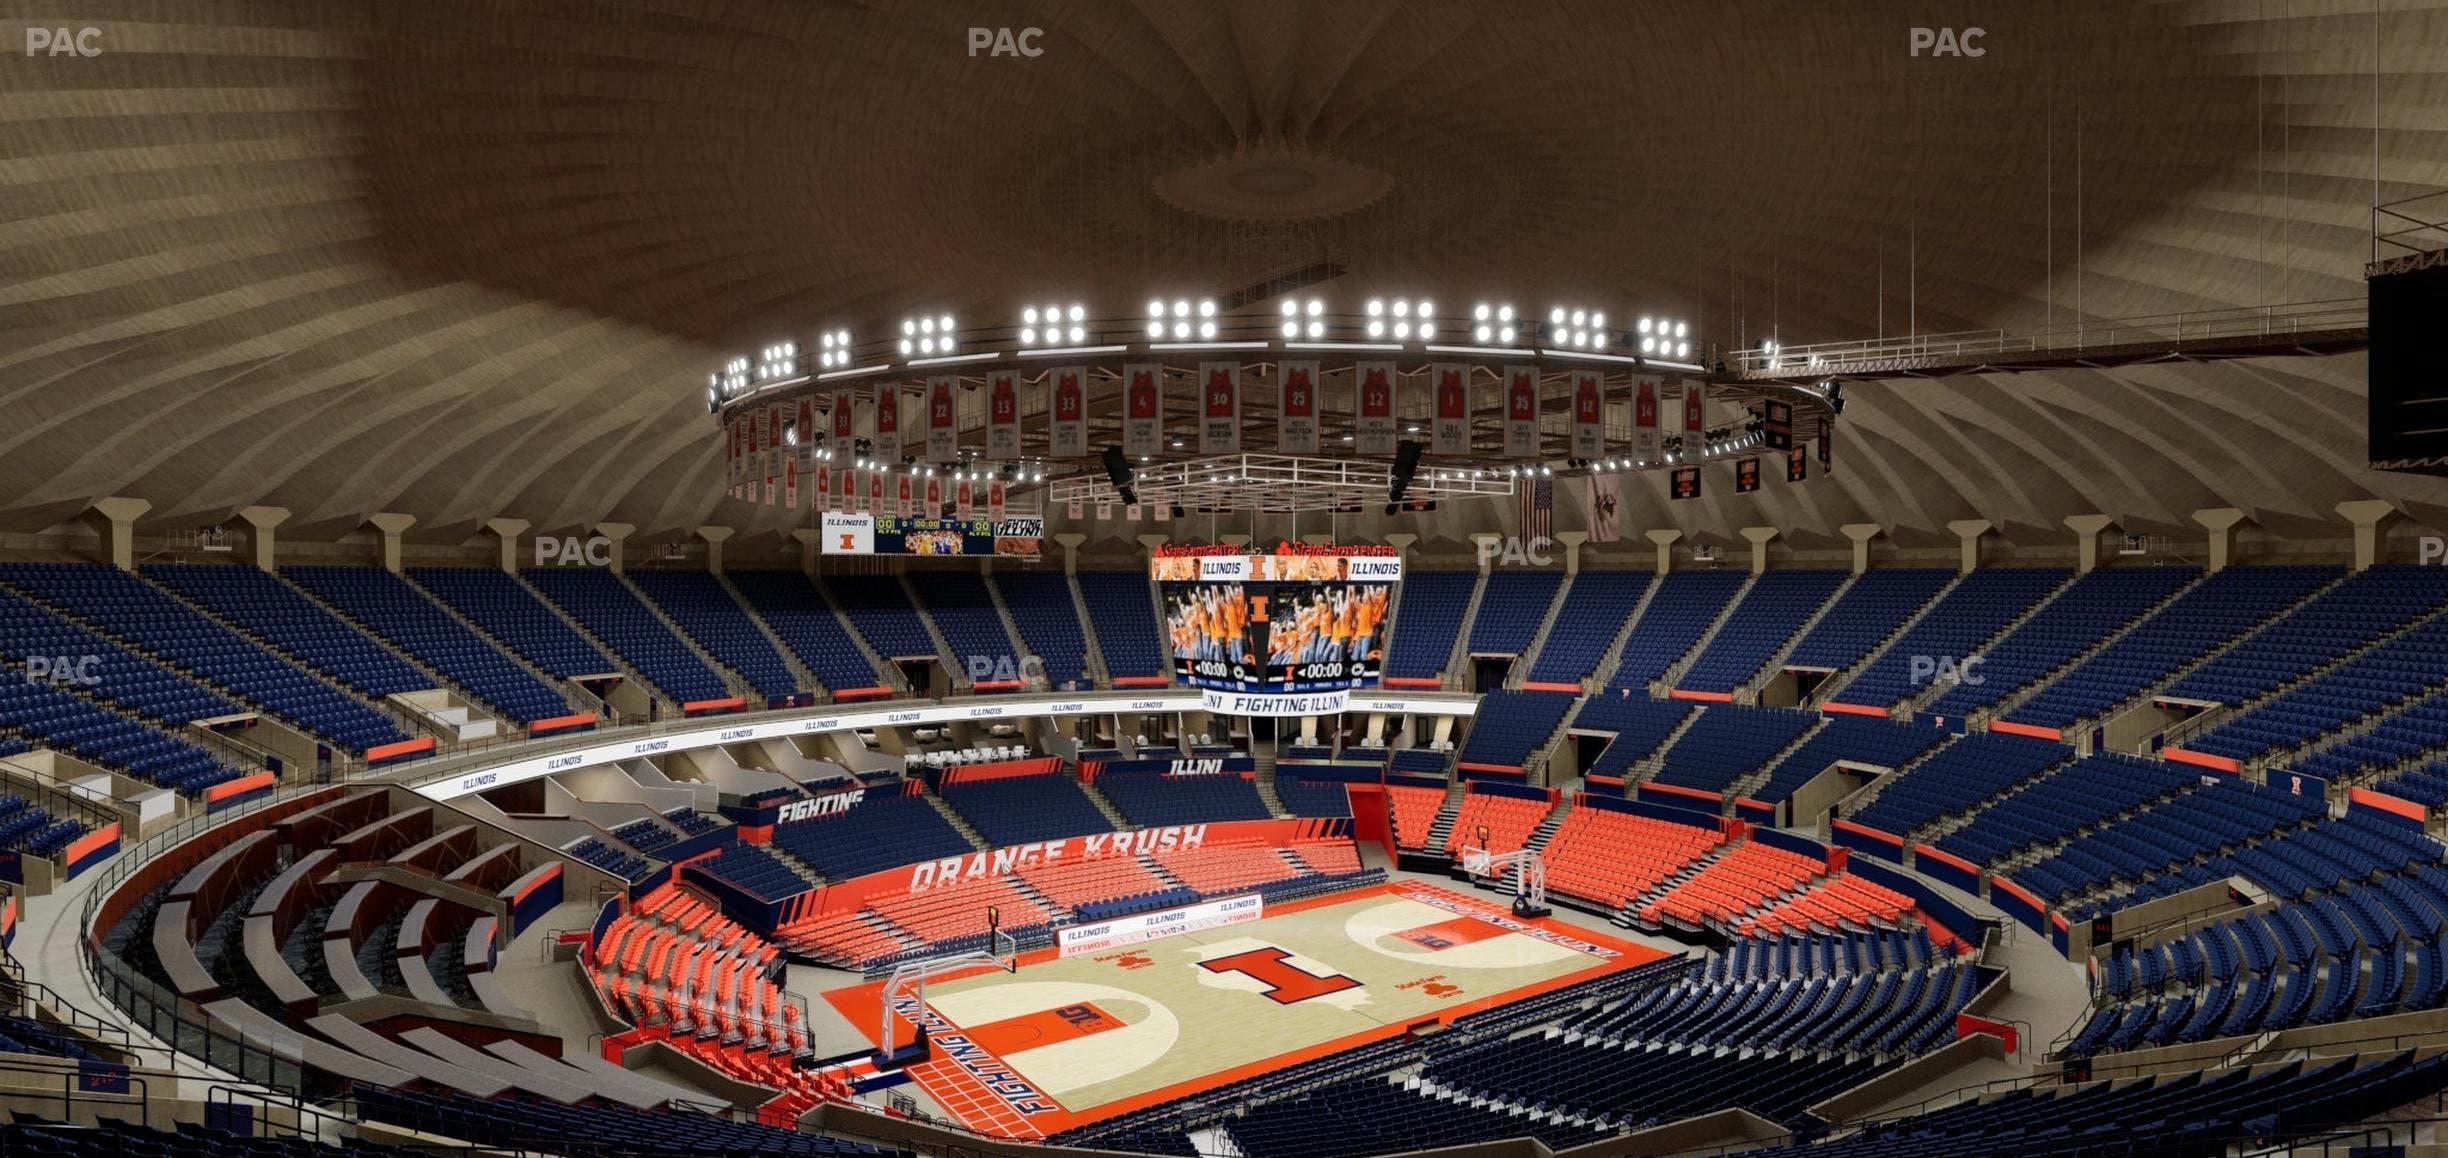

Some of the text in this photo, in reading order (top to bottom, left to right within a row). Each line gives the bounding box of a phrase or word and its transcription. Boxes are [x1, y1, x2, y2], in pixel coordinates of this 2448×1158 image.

[1062, 397, 1076, 411] 33
[1138, 396, 1147, 408] 4
[1213, 393, 1228, 405] 30
[1368, 392, 1384, 406] 12
[936, 404, 947, 418] 22
[998, 400, 1011, 414] 13
[1641, 404, 1652, 418] 14
[827, 519, 868, 527] ILLINOIS
[878, 520, 892, 529] 00
[975, 522, 990, 530] 00
[997, 527, 1041, 537] ILLINI
[1203, 562, 1241, 575] ILLINOIS
[1351, 563, 1400, 575] ILLINOIS
[1200, 660, 1227, 678] 00:00
[1306, 662, 1343, 679] 00:00
[1051, 703, 1084, 712] ILLINOIS
[1132, 701, 1164, 709] ILLINOIS
[1233, 695, 1344, 713] FIGHTING ILLINI
[1372, 702, 1405, 710] ILLINOIS
[887, 712, 921, 722] ILLINOIS
[969, 707, 1003, 716] ILLINOIS
[804, 719, 839, 730] ILLINOIS
[720, 728, 754, 740] ILLINOIS
[634, 740, 669, 753] ILLINOIS
[548, 755, 583, 769] ILLINOIS
[1170, 759, 1222, 775] ILLINI
[462, 773, 497, 790] ILLINOIS
[909, 824, 1207, 893] ORANGE KRUSH
[1220, 898, 1257, 912] ILLINOIS
[1146, 912, 1186, 926] ILLINOIS
[1068, 926, 1111, 941] ILLINOIS
[931, 1034, 1061, 1117] FIGHTING
